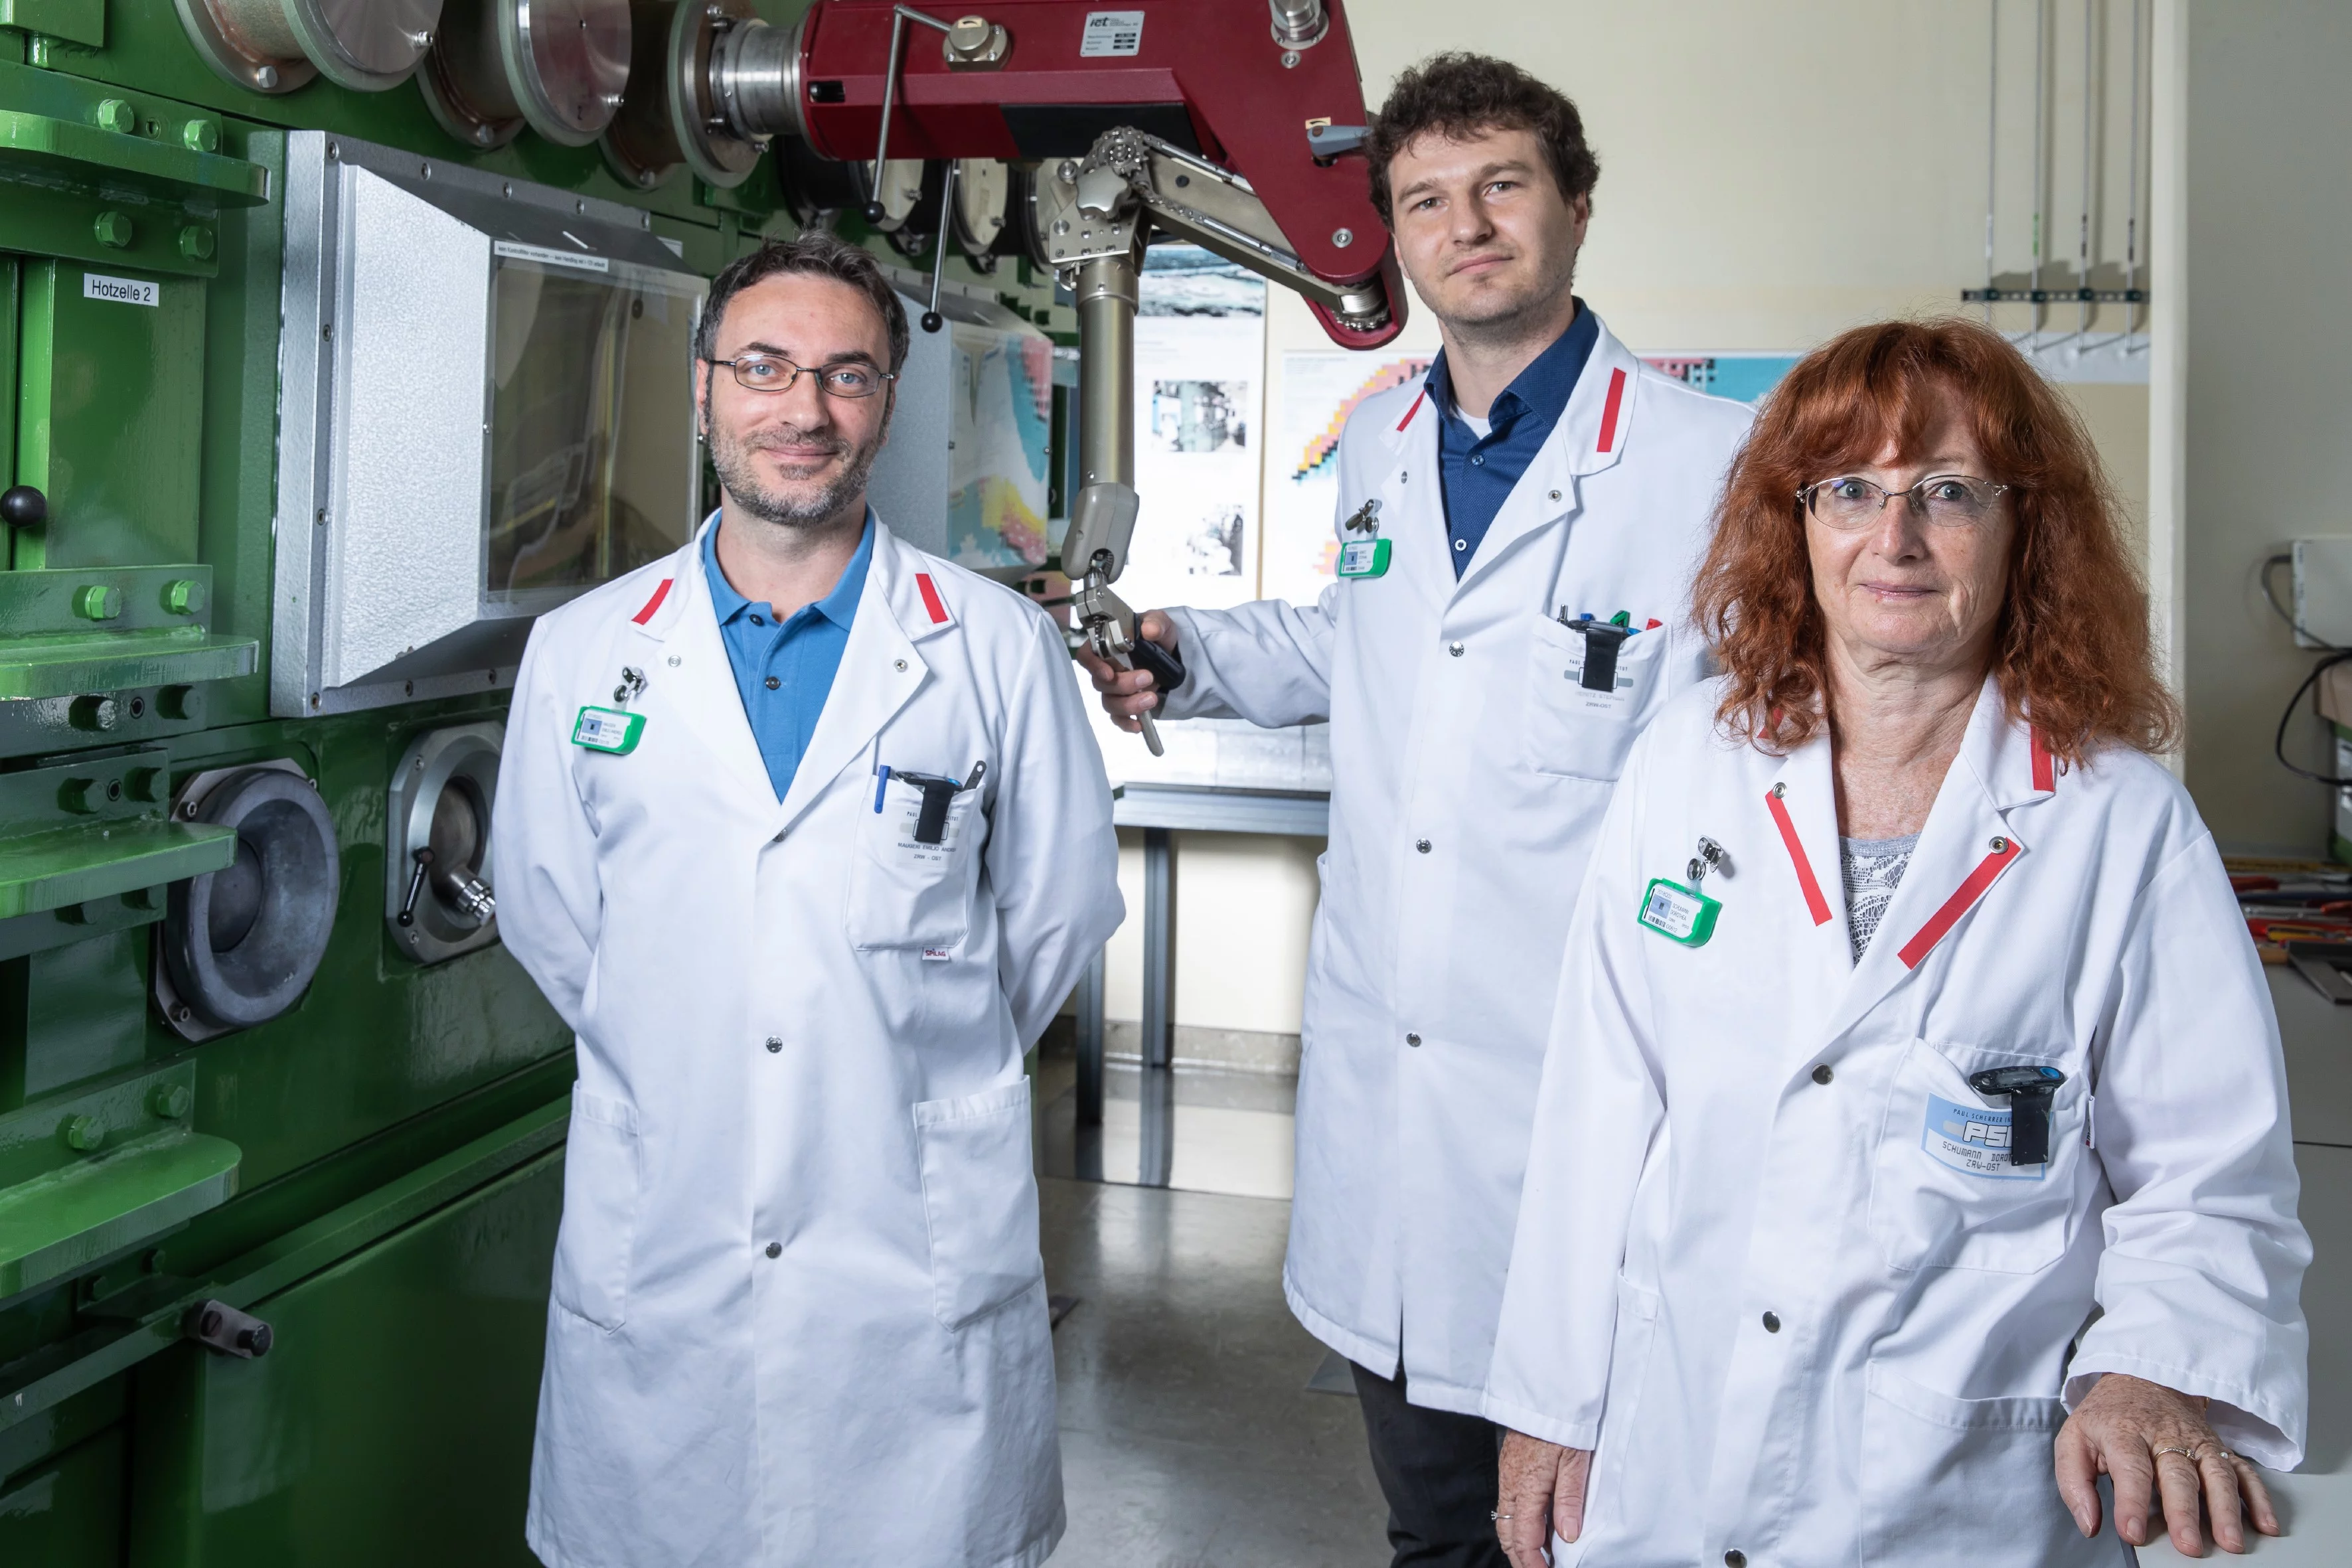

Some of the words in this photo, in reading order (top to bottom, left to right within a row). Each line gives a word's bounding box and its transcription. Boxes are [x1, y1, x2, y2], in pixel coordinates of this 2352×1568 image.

[92, 279, 141, 301] Hotzelle
[143, 286, 151, 302] 2
[1670, 909, 1687, 921] DOROTHEA
[1672, 903, 1689, 915] SCHUMANN
[1954, 1108, 1969, 1118] PAUL
[1971, 1113, 2003, 1123] SCHERRER
[1942, 1140, 1982, 1160] SCHUMANN
[1966, 1159, 2001, 1172] ZRW-OST
